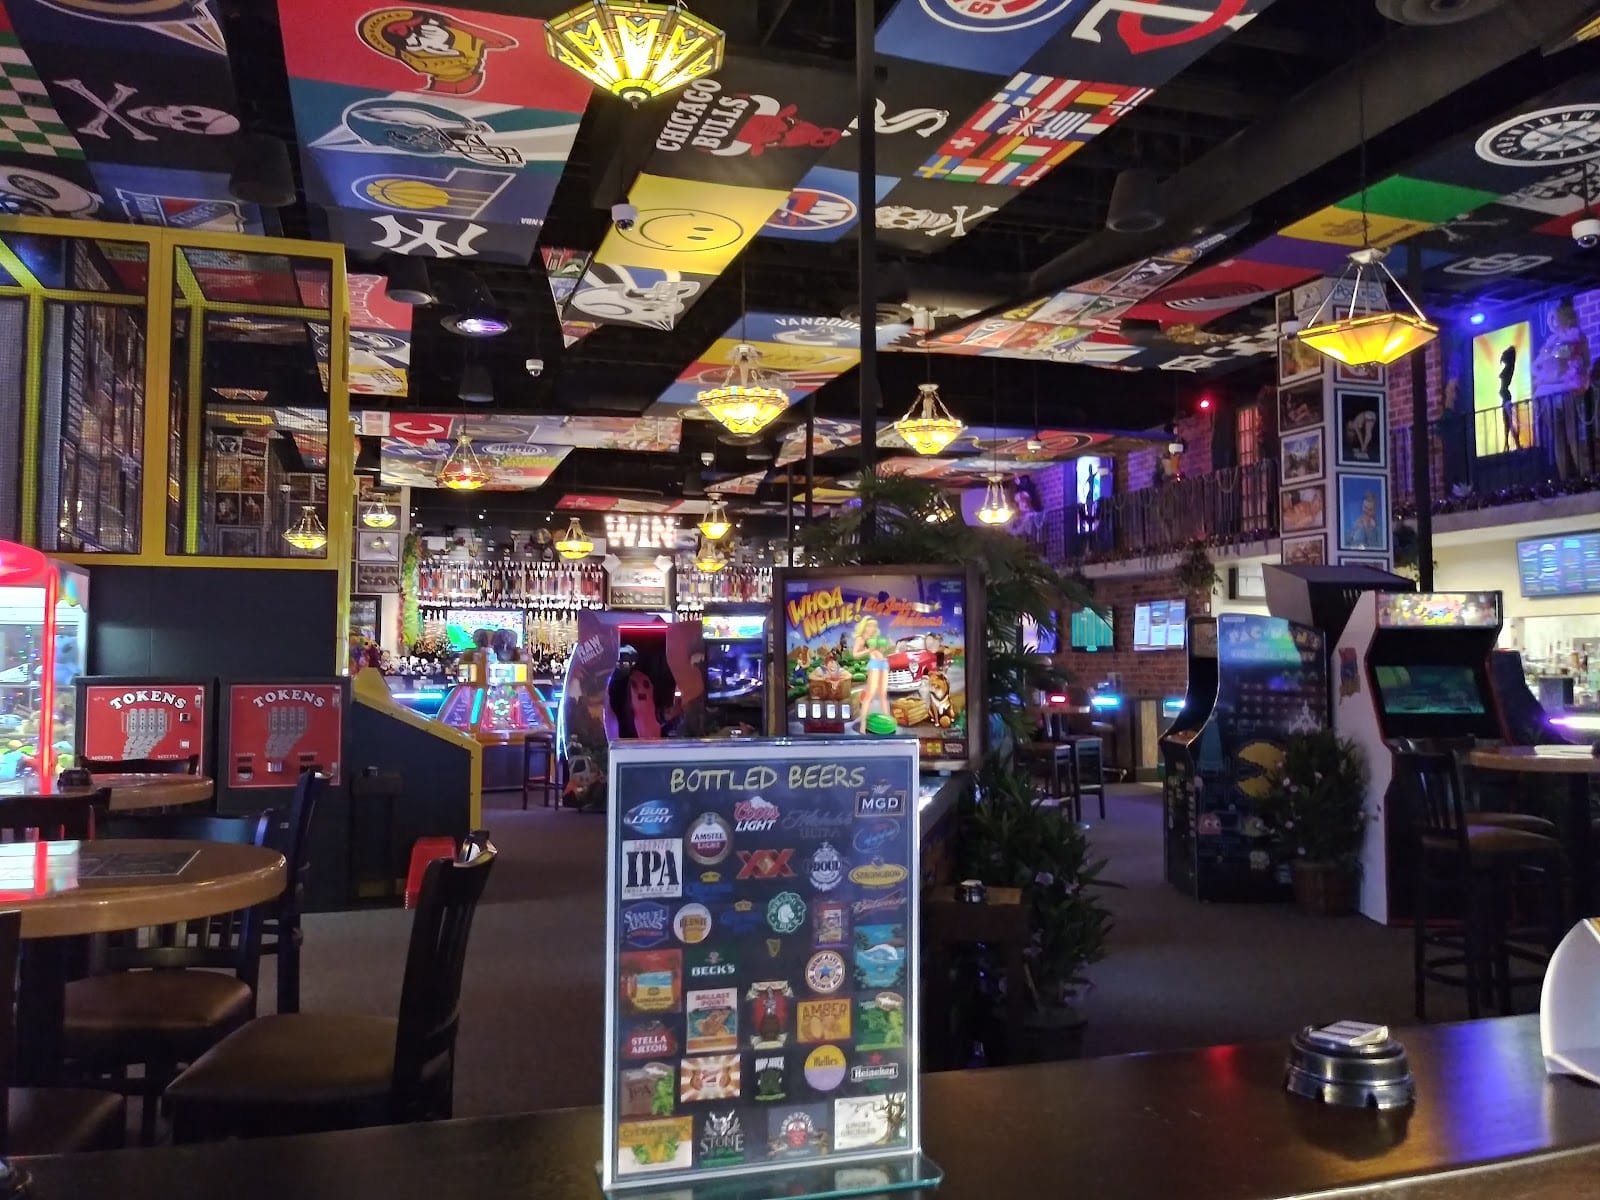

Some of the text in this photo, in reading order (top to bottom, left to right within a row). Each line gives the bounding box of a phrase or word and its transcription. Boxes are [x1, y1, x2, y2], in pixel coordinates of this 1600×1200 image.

[656, 79, 722, 151] CHICAGO
[692, 96, 749, 149] BULLS
[788, 586, 843, 628] WHOA
[110, 690, 187, 709] TOKENS
[253, 689, 326, 708] TOKENS
[670, 764, 866, 793] BOTTLED BEERS
[862, 797, 899, 810] MGD
[640, 807, 669, 816] BUD
[632, 815, 673, 824] LIGHT
[735, 819, 777, 832] LIGHT
[694, 832, 724, 841] AMSTEL
[626, 849, 680, 888] IPA
[624, 909, 668, 925] SAMUEL
[627, 919, 664, 933] ADAMS
[691, 964, 736, 977] BECK'S
[802, 1003, 848, 1018] AMBER
[631, 1035, 667, 1045] STELLA
[632, 1044, 668, 1054] ARTOIS
[854, 1066, 895, 1079] Heineken
[700, 1134, 744, 1156] STONE
